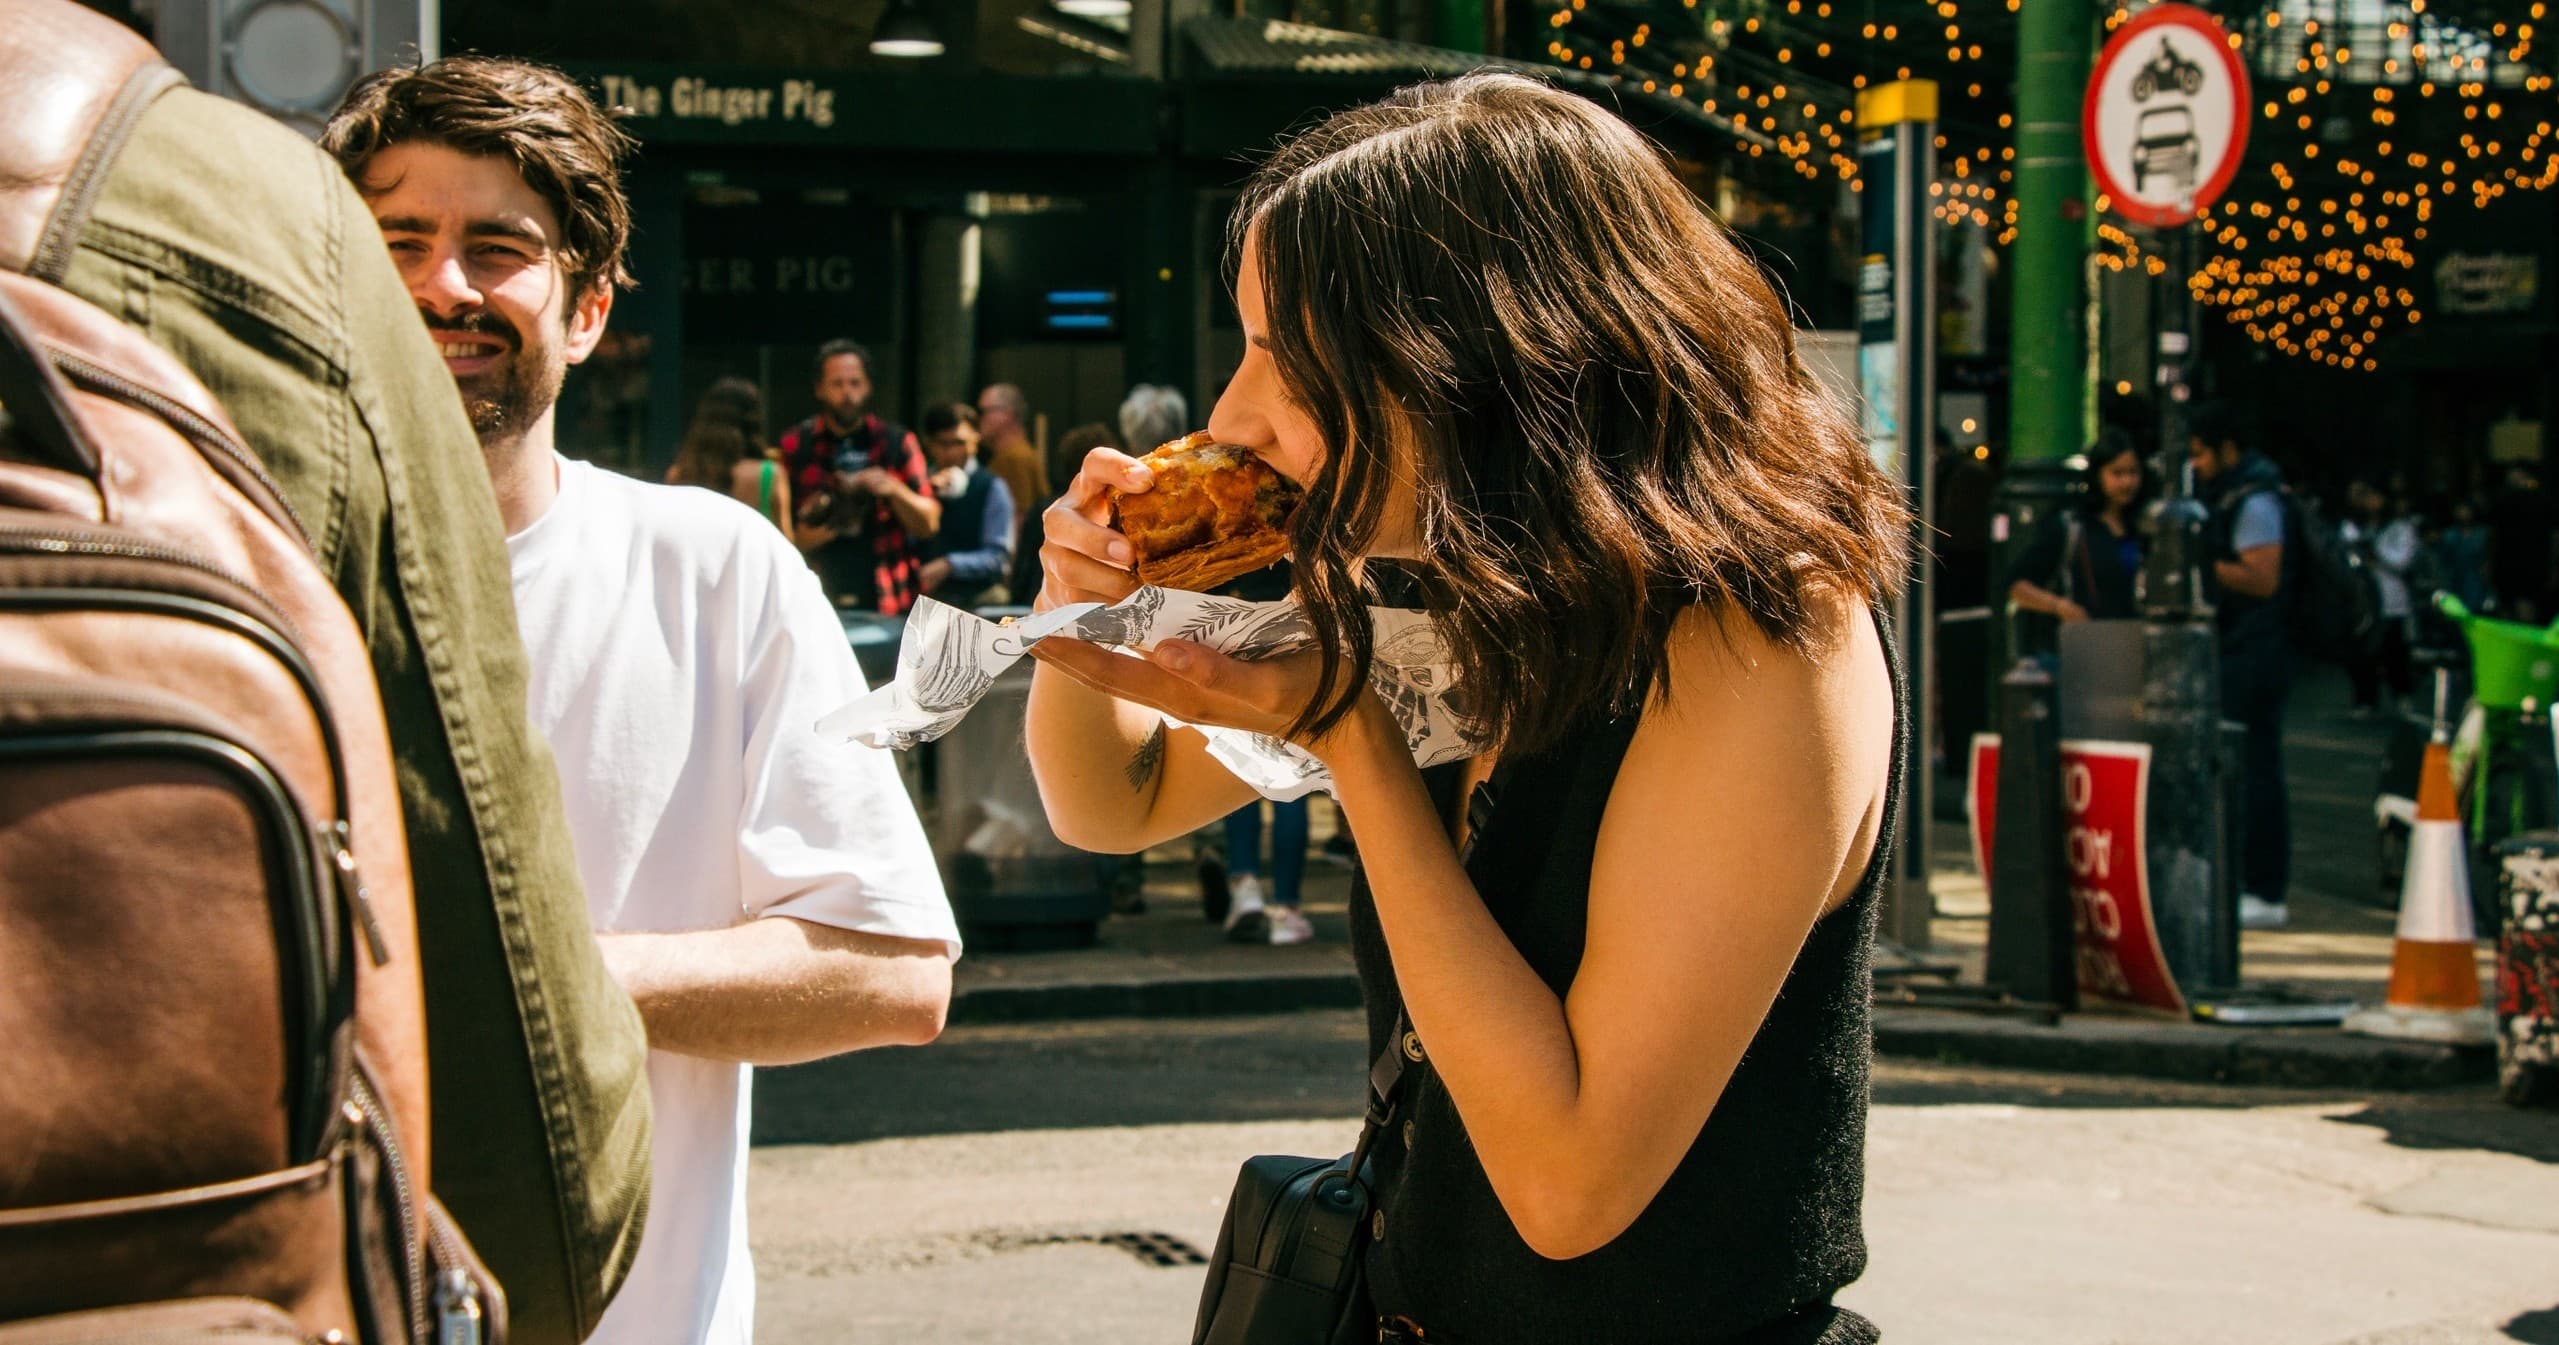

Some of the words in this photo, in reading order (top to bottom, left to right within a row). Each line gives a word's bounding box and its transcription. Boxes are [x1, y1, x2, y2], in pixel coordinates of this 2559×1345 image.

[602, 75, 662, 117] The
[671, 77, 773, 126] Ginger
[783, 79, 834, 127] Pig
[776, 255, 854, 293] PIG
